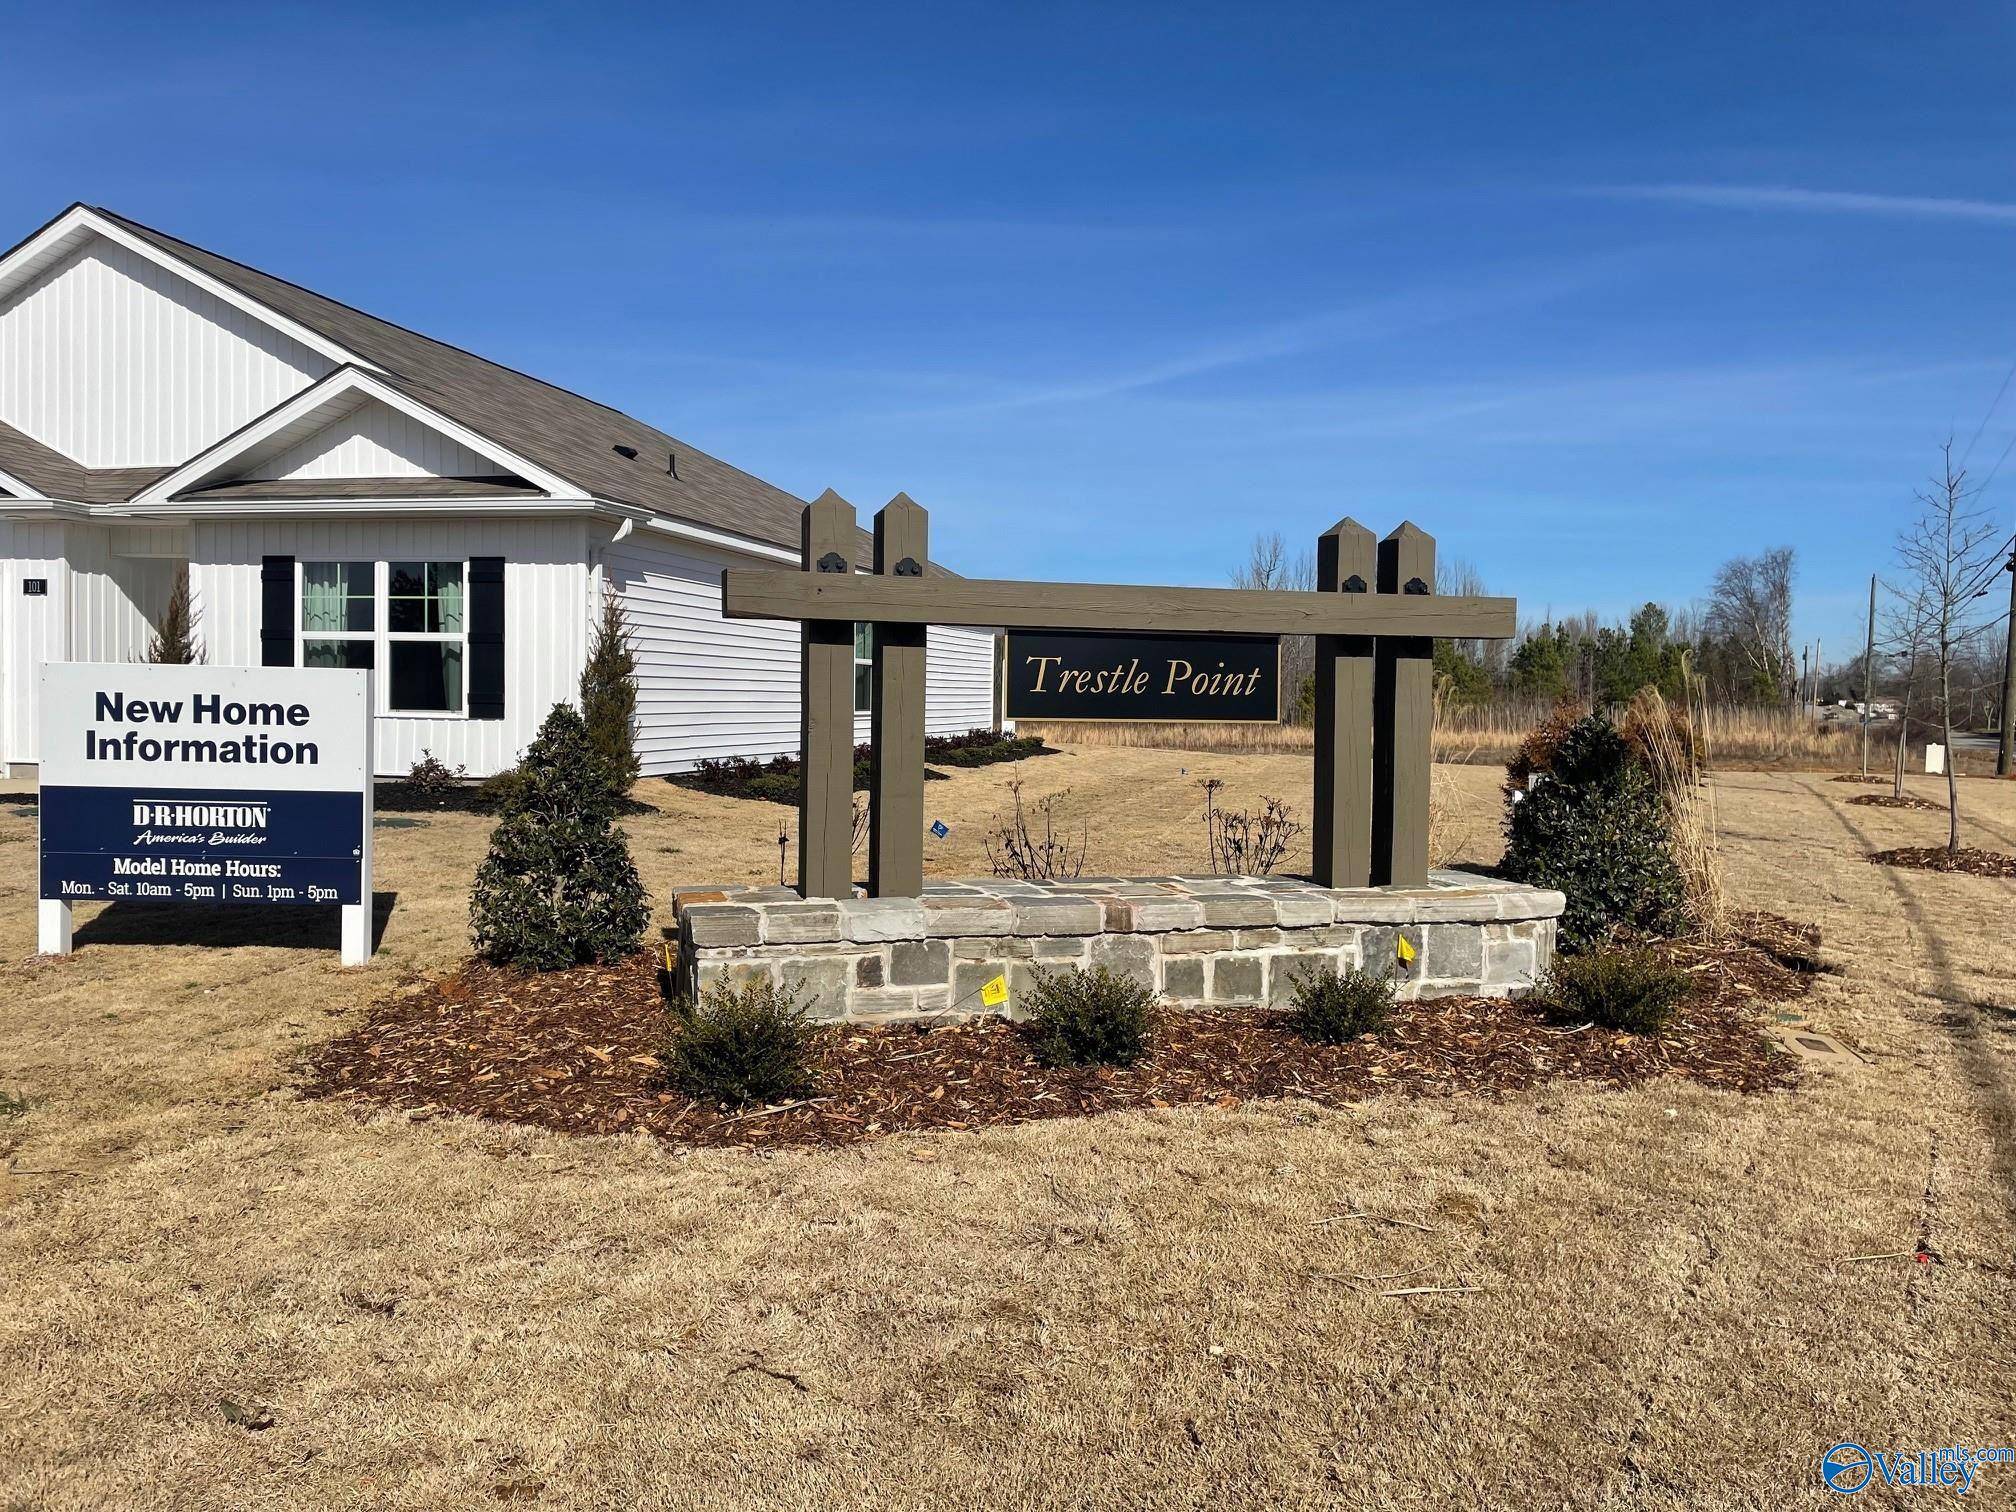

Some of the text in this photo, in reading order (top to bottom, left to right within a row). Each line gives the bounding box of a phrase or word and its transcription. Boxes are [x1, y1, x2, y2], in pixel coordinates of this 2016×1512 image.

[28, 581, 40, 592] 101
[1025, 655, 1262, 696] Trestle Point
[95, 691, 310, 726] New Home
[86, 730, 319, 765] Information
[132, 830, 267, 846] America's Builder
[113, 858, 282, 878] Model Home Hours:
[61, 880, 95, 895] Mon.
[107, 881, 133, 896] Sat.
[137, 881, 172, 897] 10am
[184, 882, 216, 900] 5pm
[233, 884, 264, 899] Sun.
[267, 884, 296, 902] 1pm
[308, 885, 338, 902] 5pm
